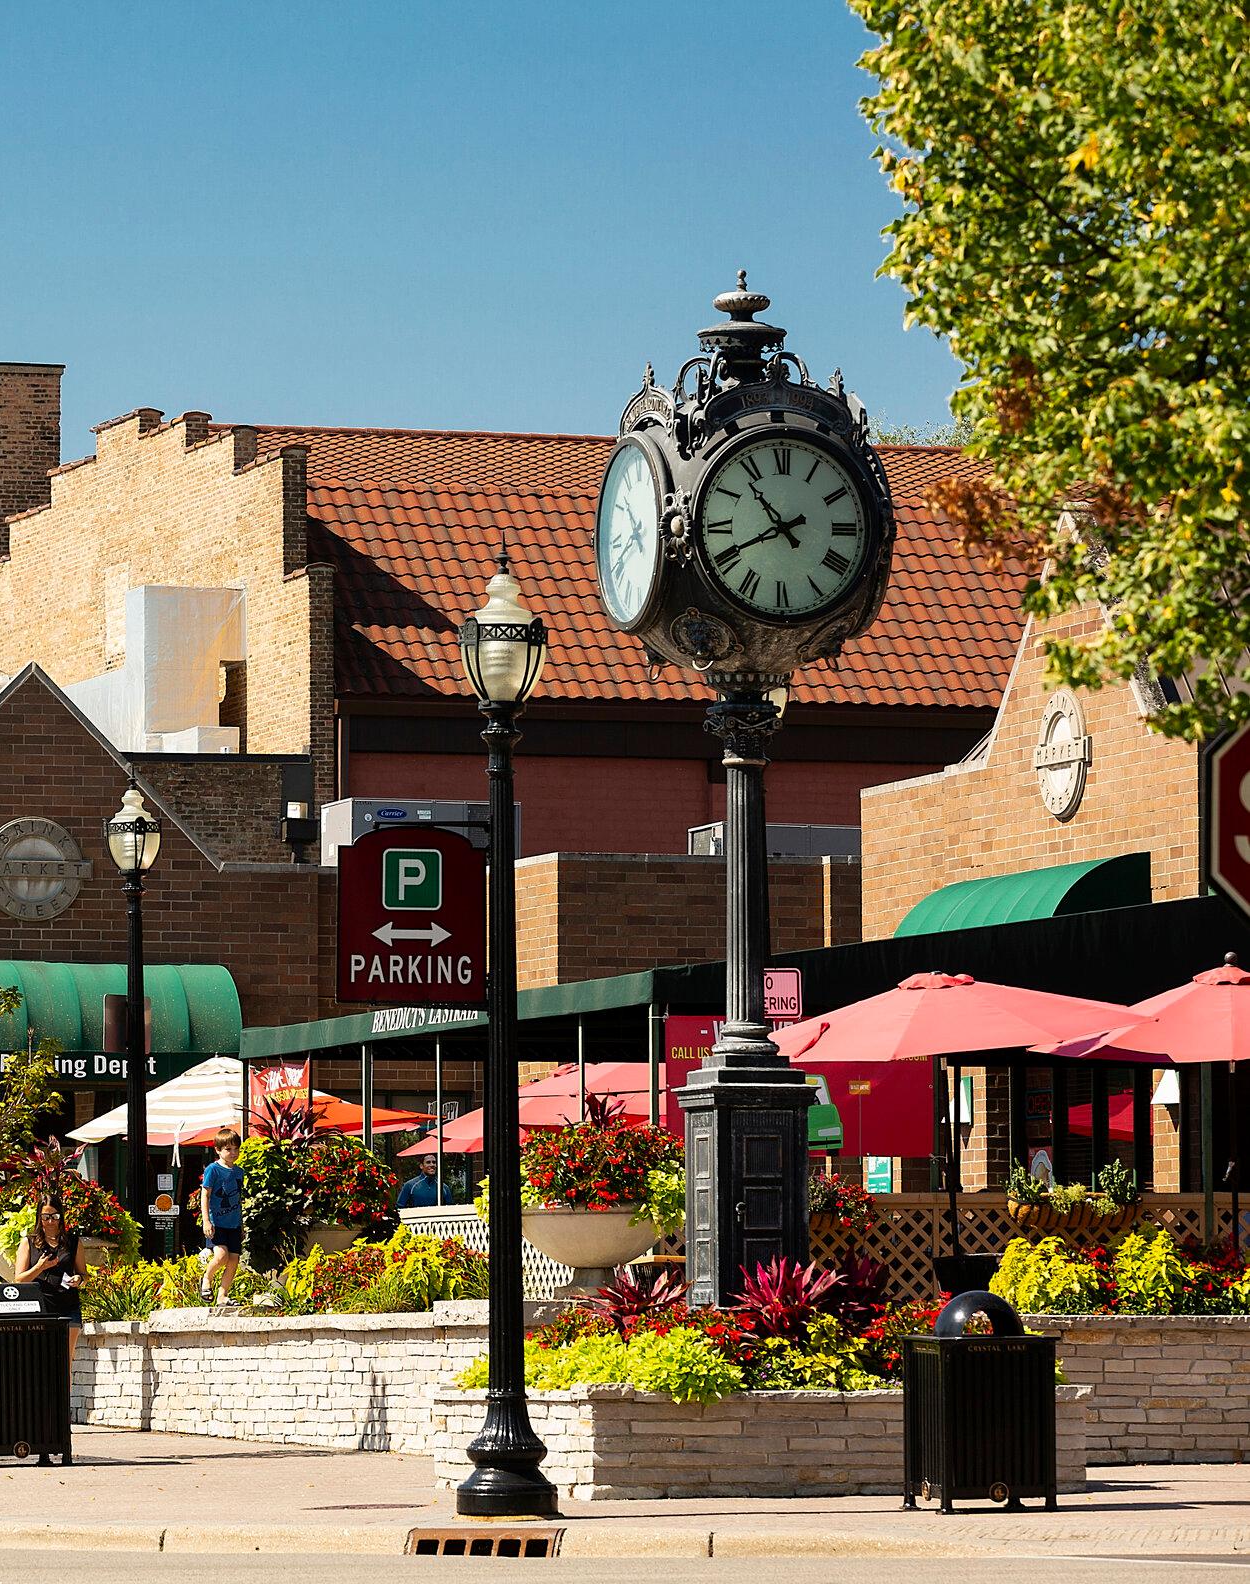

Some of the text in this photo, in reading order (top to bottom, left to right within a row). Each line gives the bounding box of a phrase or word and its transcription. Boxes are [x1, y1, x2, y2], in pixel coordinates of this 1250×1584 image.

[380, 809, 405, 818] Carrier
[398, 858, 427, 901] P
[350, 954, 472, 985] PARKING
[764, 976, 774, 990] O
[371, 1006, 427, 1034] BENEDICT'S
[671, 1046, 710, 1059] CALL US
[94, 1054, 157, 1079] Dept
[967, 1343, 1028, 1352] CRYSTAL LAKE
